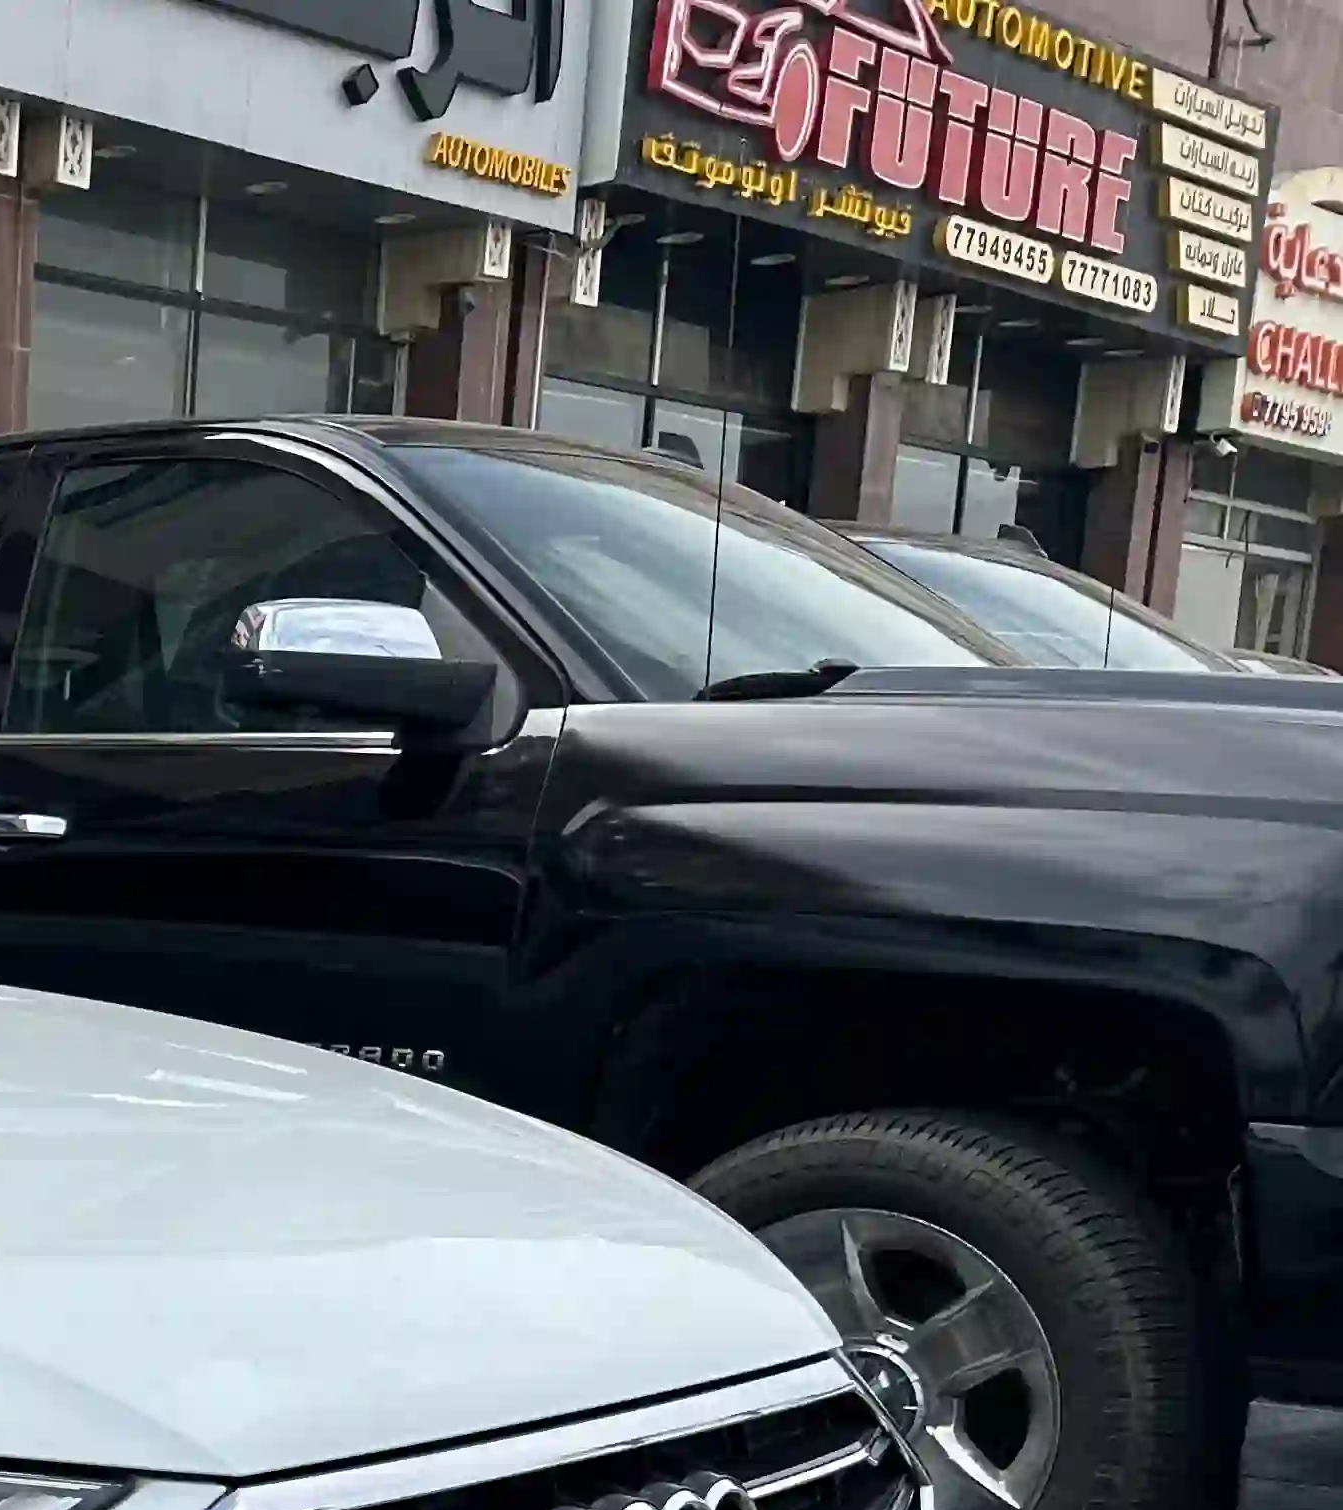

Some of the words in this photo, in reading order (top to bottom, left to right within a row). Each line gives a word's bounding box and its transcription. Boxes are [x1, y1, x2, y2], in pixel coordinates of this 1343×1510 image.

[927, 0, 1149, 100] AUTOMOTIVE
[429, 132, 573, 195] AUTOMOBILES
[815, 25, 1139, 255] FUTURE
[952, 222, 1049, 276] 77949455
[1067, 259, 1153, 308] 77771083
